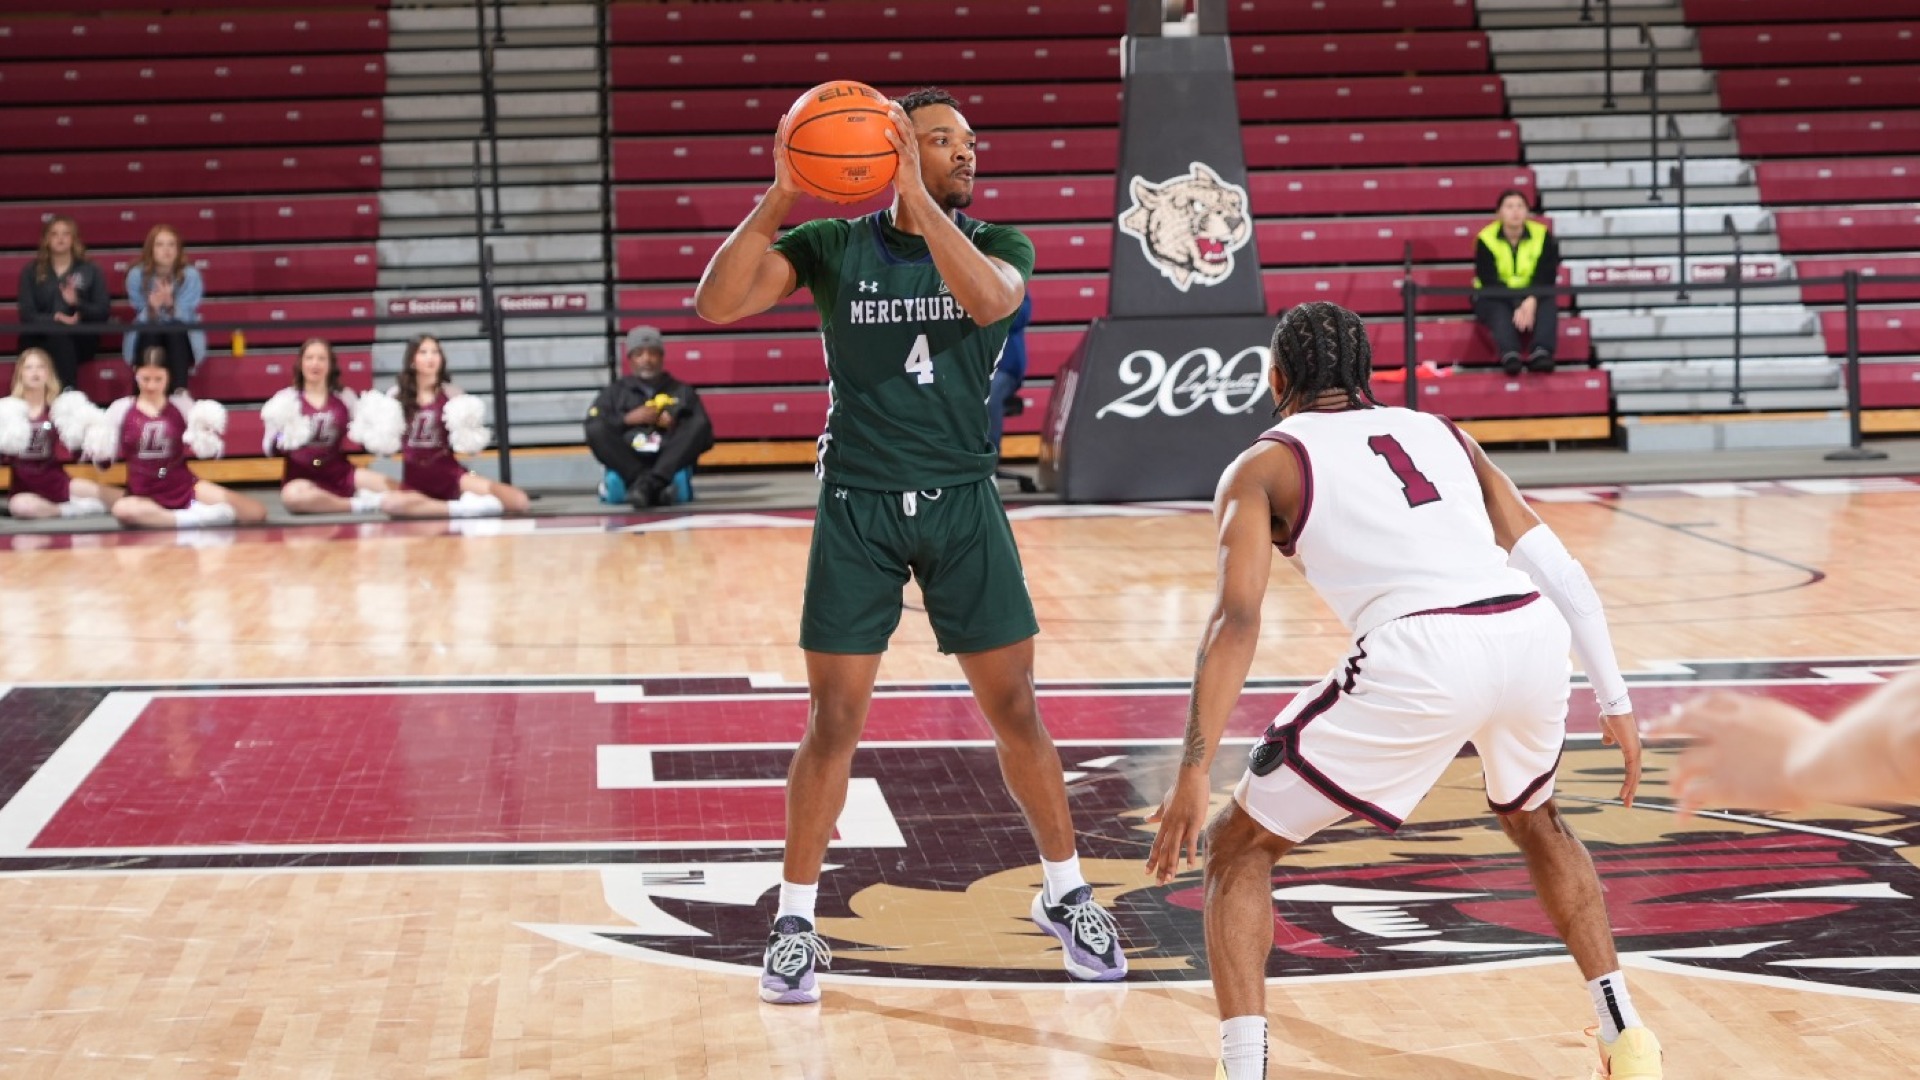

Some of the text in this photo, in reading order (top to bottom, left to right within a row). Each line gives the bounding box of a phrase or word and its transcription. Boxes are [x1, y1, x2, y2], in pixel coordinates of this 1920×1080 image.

[408, 299, 457, 314] Section
[500, 296, 550, 310] Section
[850, 296, 972, 324] MERCYHURS
[904, 333, 934, 385] 4
[1096, 346, 1272, 419] 200
[138, 421, 171, 459] L
[1367, 433, 1442, 508] 1
